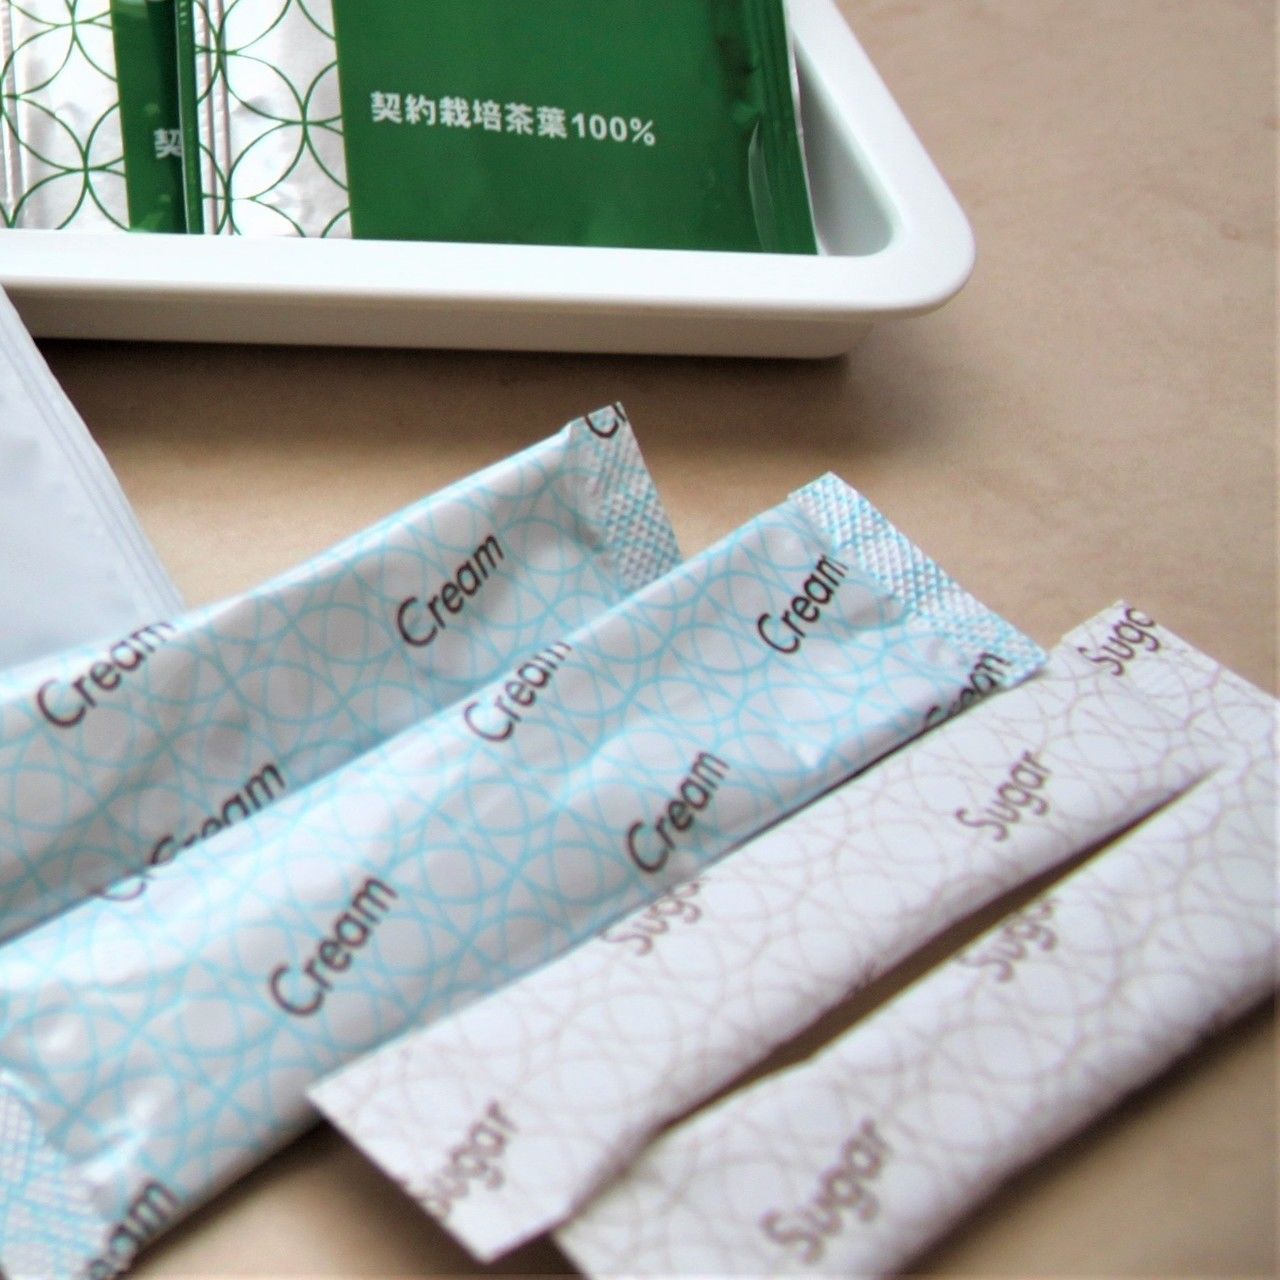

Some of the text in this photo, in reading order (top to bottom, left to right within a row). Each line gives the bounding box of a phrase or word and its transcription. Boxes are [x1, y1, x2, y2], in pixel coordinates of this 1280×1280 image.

[397, 533, 506, 649] Cream
[757, 554, 849, 654] Cream
[37, 621, 177, 729] Cream
[463, 640, 573, 743] Cream
[925, 652, 1012, 728] eam
[626, 750, 731, 875] Cream
[954, 749, 1053, 843] Sugar
[268, 875, 398, 1018] Cream
[598, 877, 708, 957] Sug
[958, 897, 1061, 984] Sug
[758, 1115, 893, 1266] Sugar
